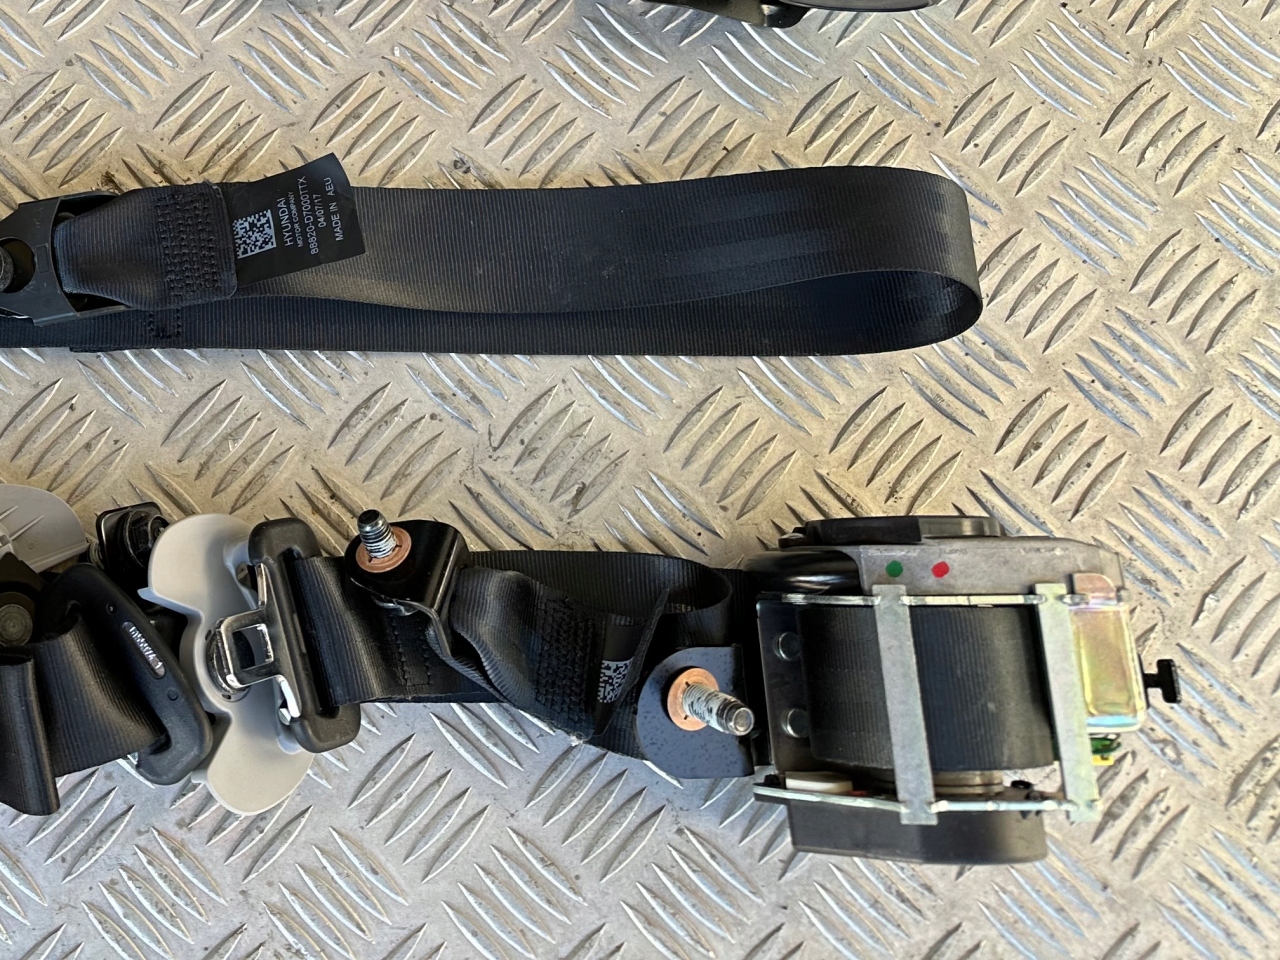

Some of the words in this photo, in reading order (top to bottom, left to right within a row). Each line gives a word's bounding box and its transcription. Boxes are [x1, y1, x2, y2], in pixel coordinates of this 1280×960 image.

[323, 177, 336, 196] AEU
[287, 191, 299, 222] COMPANY
[297, 175, 319, 255] 88820-D7000TTX
[312, 194, 327, 228] 04/07/17
[328, 201, 339, 213] IN
[276, 197, 294, 247] HYUNDAI
[293, 222, 304, 248] MOTOR
[331, 213, 345, 241] MADE
